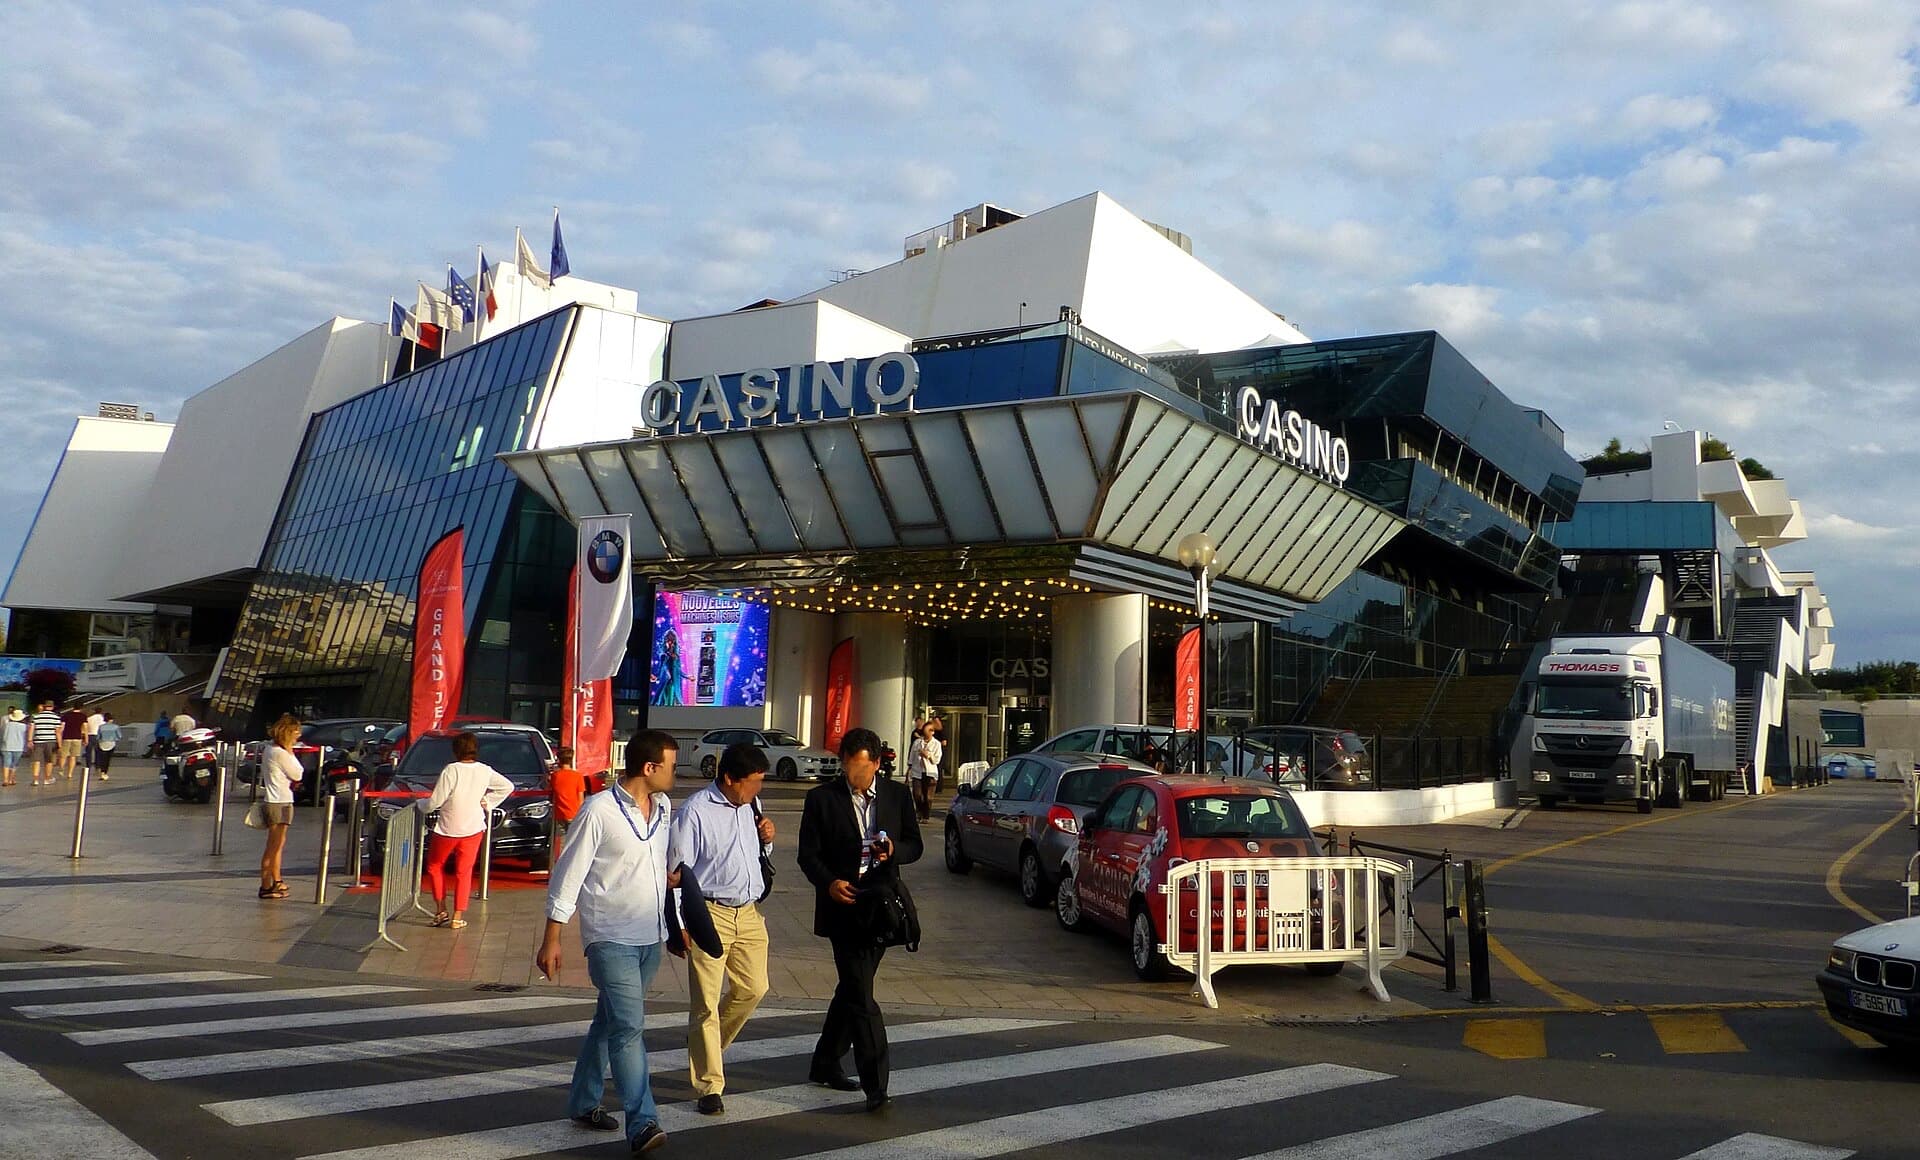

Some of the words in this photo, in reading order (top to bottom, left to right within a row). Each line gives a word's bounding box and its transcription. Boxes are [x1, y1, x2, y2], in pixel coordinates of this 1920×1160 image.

[641, 352, 919, 428] CASINO
[1237, 386, 1350, 481] CASINO
[681, 594, 740, 611] NOUVELLES
[722, 611, 740, 623] SOUS
[431, 608, 444, 681] GRAND
[990, 657, 1049, 678] CAS
[1550, 663, 1620, 673] THOMAS'S
